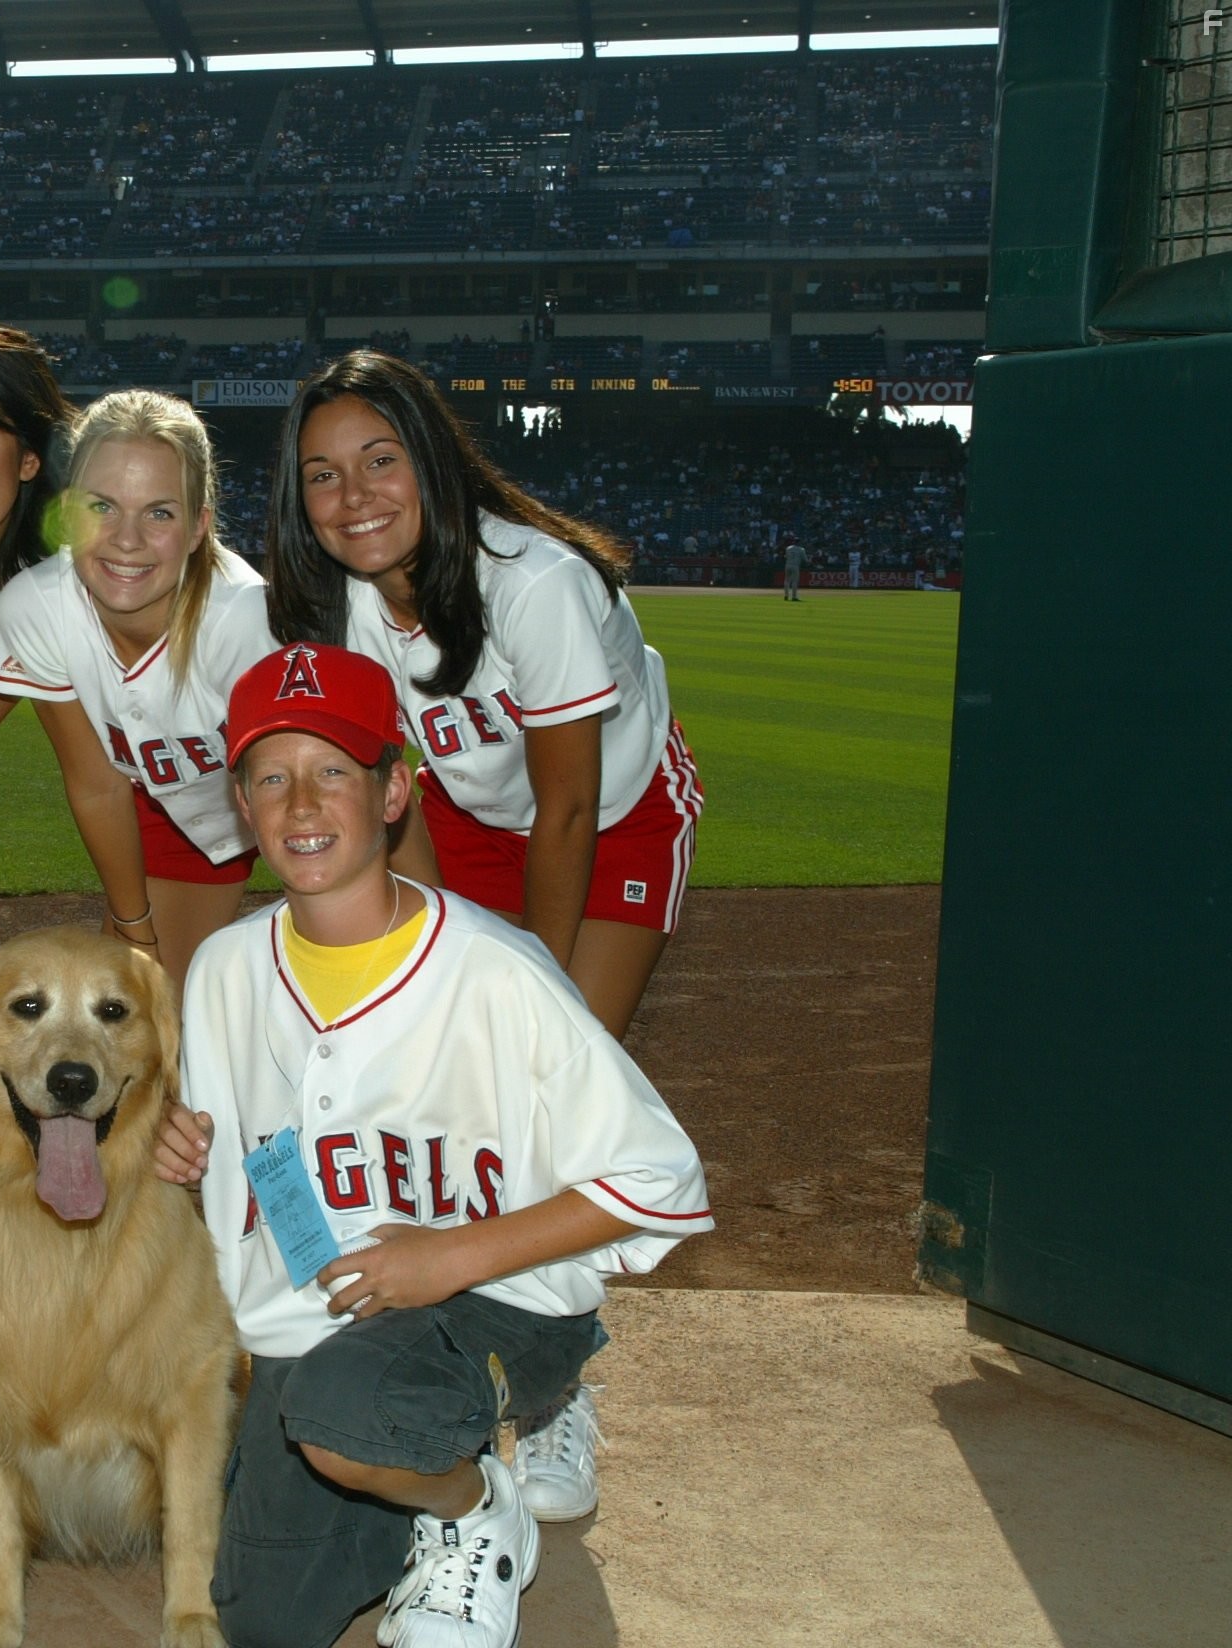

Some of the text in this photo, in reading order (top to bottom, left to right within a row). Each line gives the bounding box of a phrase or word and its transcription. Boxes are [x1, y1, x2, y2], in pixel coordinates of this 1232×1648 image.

[223, 382, 288, 396] EDISON
[451, 379, 485, 391] FROM
[502, 379, 526, 391] THE
[550, 379, 575, 391] 6TH
[591, 379, 636, 391] INNING
[833, 379, 873, 392] 4:50
[715, 386, 751, 398] BANK
[762, 386, 798, 398] WEST
[809, 571, 934, 581] TOYOA DEALES
[274, 644, 326, 701] A
